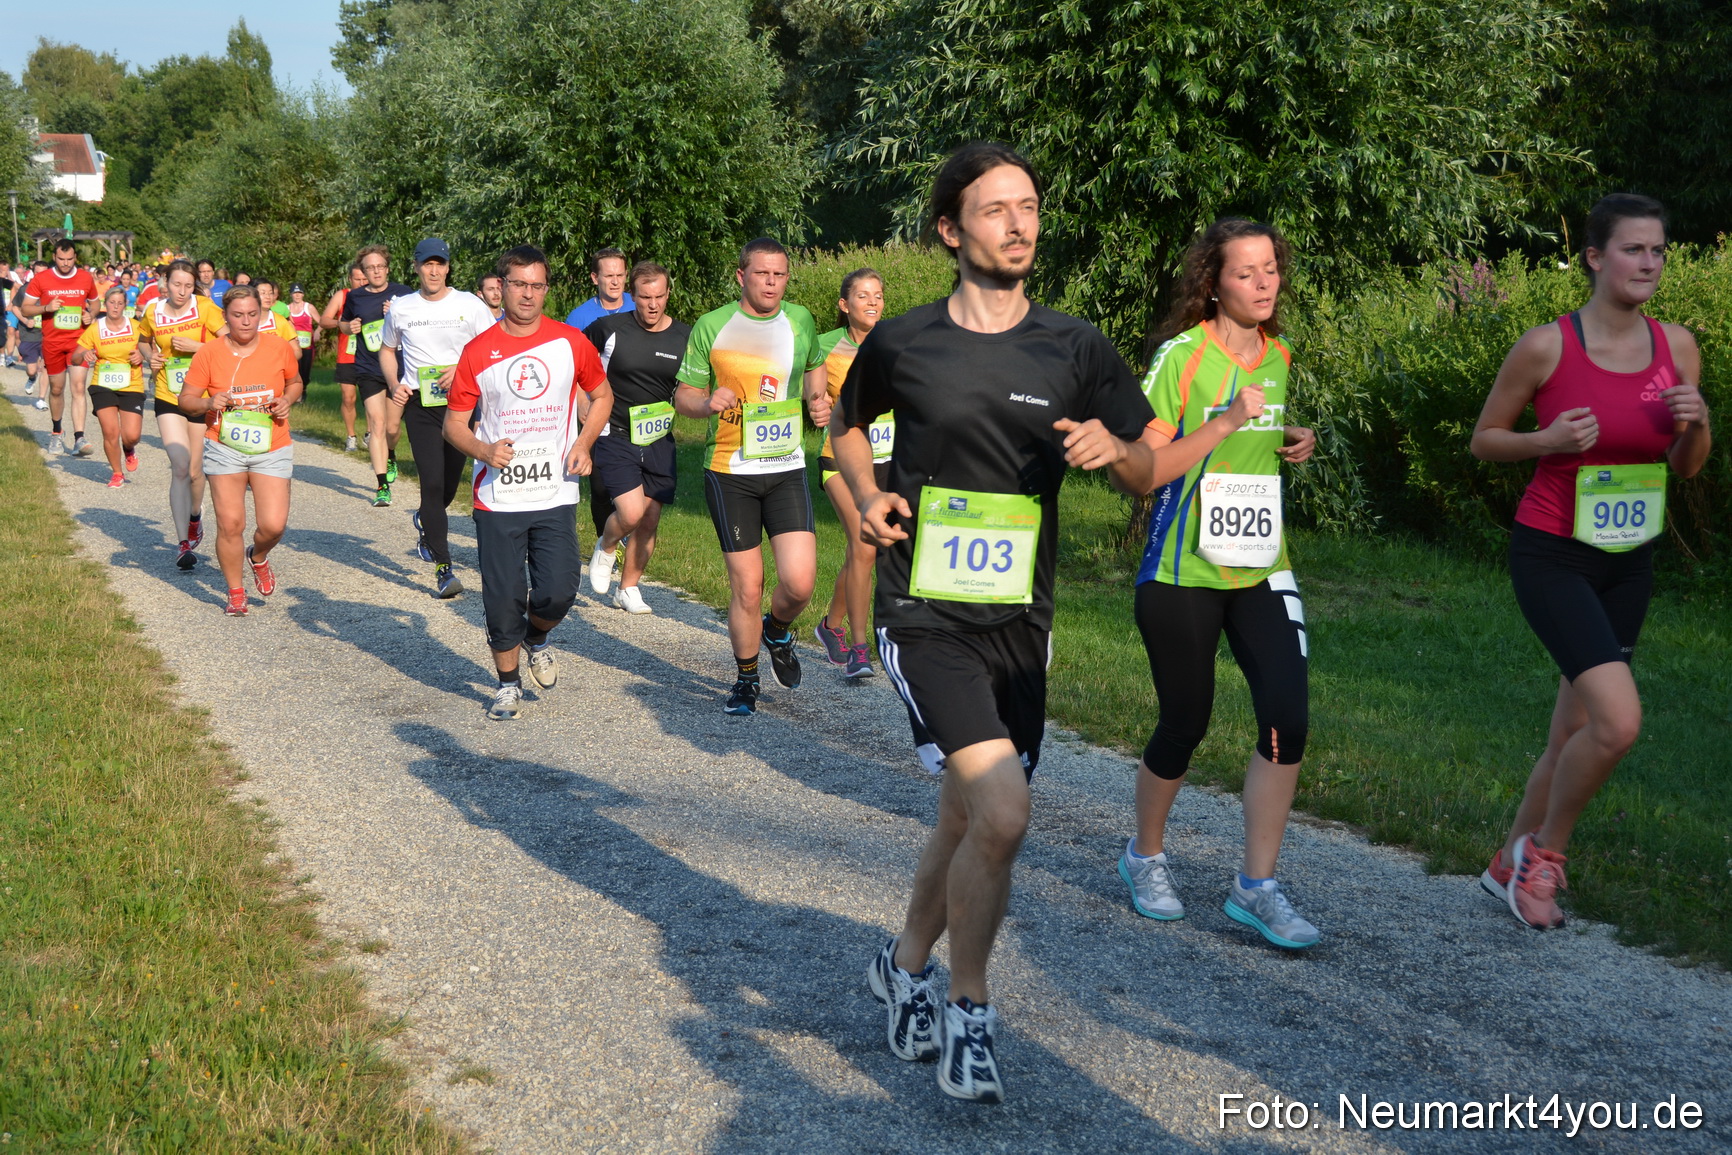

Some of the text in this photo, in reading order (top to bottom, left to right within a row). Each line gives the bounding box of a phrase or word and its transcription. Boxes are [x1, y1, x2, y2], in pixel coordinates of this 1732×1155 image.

[58, 315, 79, 323] 1410
[408, 319, 460, 328] globalconcepts
[156, 321, 201, 336] MAX BÖGL
[104, 374, 124, 383] 869
[176, 371, 188, 384] 8
[245, 384, 266, 392] Jahre
[1009, 392, 1049, 407] Joel Comes
[636, 417, 671, 435] 1086
[756, 422, 792, 442] 994
[230, 427, 262, 444] 613
[500, 461, 553, 485] 8944
[497, 484, 558, 494] www.df-sports.de
[1205, 478, 1267, 495] df-sports
[1209, 506, 1272, 538] 8926
[1593, 500, 1646, 529] 908
[943, 535, 1013, 573] 103
[1203, 543, 1277, 551] www.df-sports.de
[970, 579, 995, 587] Comes
